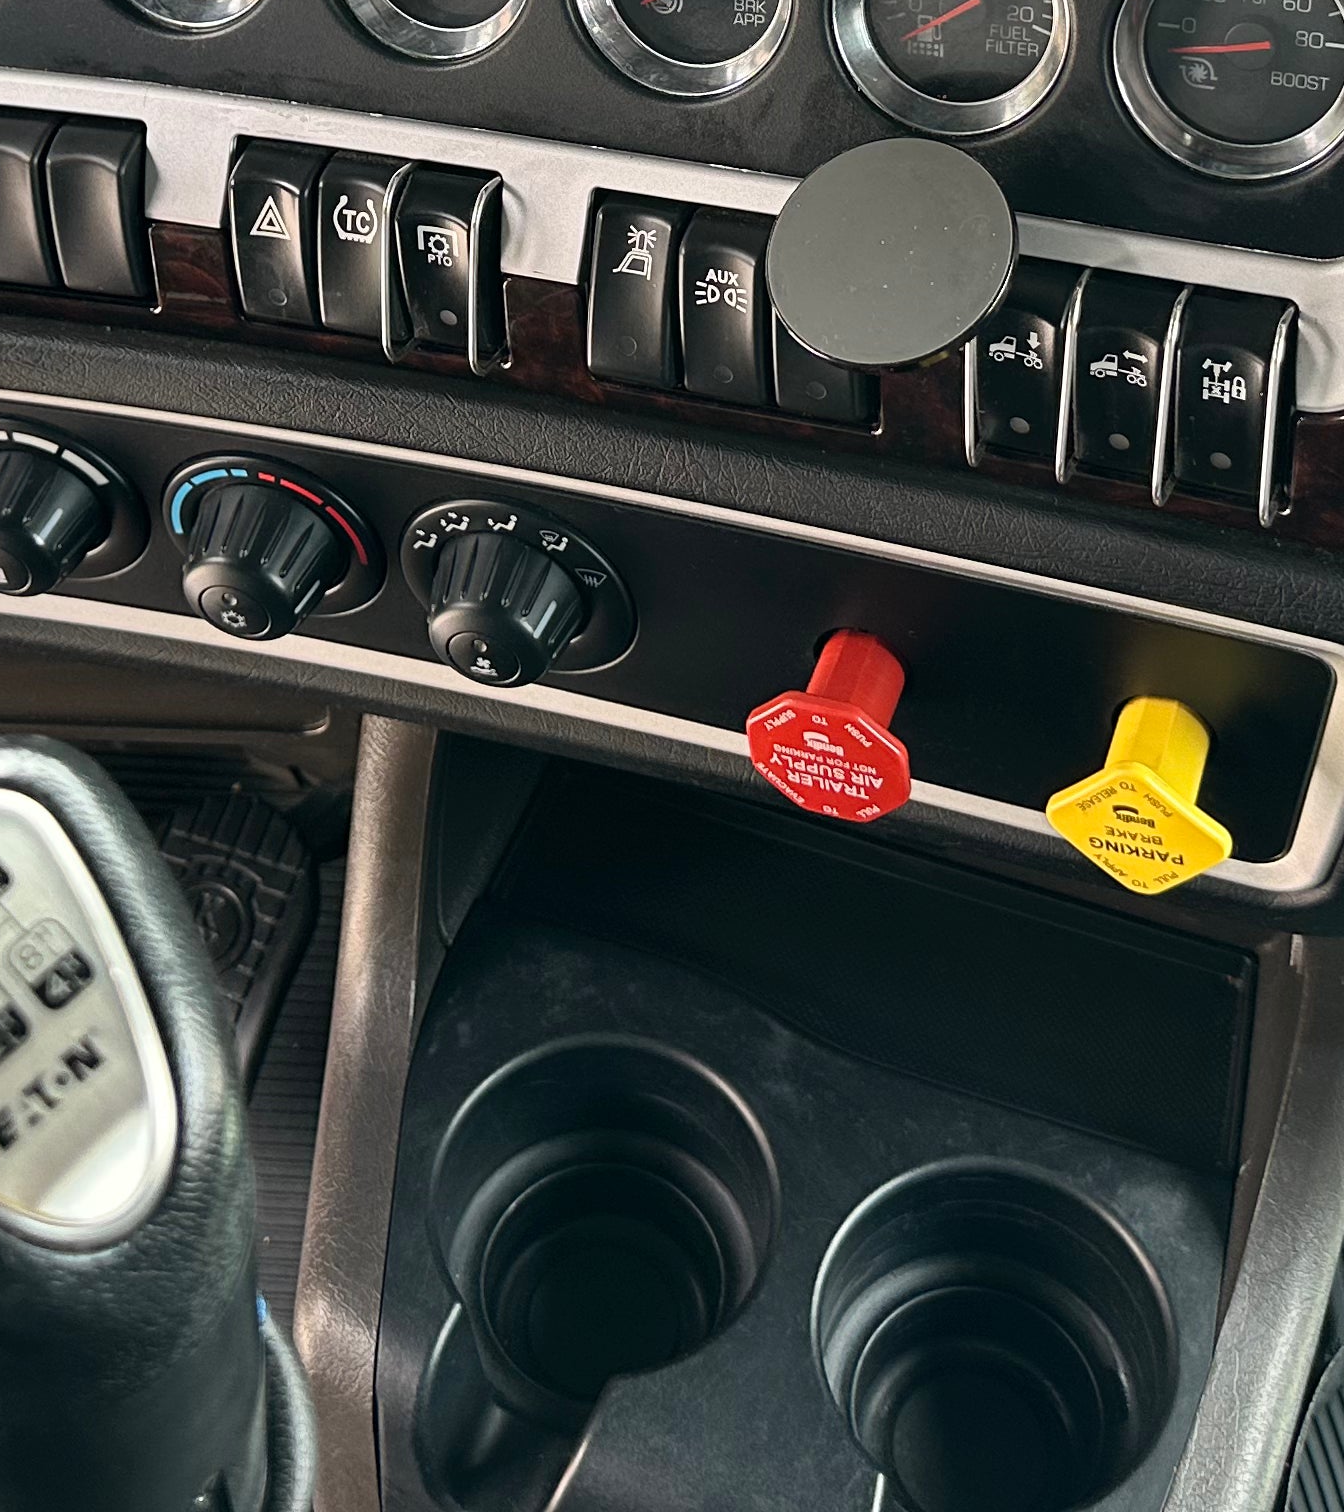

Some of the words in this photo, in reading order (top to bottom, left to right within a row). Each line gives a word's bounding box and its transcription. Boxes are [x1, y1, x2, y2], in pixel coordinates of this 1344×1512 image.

[732, 13, 766, 27] APP
[1007, 5, 1034, 23] 20
[989, 24, 1031, 42] FUEL
[1181, 17, 1196, 33] 0
[985, 39, 1039, 57] FILTER
[1295, 31, 1324, 49] 80
[1270, 71, 1331, 91] BOOST
[342, 209, 371, 234] TC
[428, 253, 454, 268] PTO
[706, 268, 739, 287] AUX
[762, 709, 798, 732] SUPPLY
[811, 714, 829, 727] TO
[843, 723, 873, 748] PUSH
[773, 743, 824, 764] PARKING
[806, 739, 845, 757] Bendix
[769, 752, 846, 781] SUPPLY
[825, 756, 847, 768] FOR
[849, 760, 877, 774] NOT
[755, 761, 806, 805] EVACUATE
[786, 769, 870, 800] TRAILER
[851, 773, 884, 790] AIR
[1119, 780, 1137, 793] TO
[1075, 785, 1118, 812] RELEASE
[1143, 793, 1173, 818] PUSH
[822, 804, 840, 817] TO
[855, 803, 881, 819] PULL
[1115, 812, 1156, 829] Bendix
[1104, 825, 1164, 846] BRAKE
[1088, 836, 1185, 866] PARKING
[1093, 853, 1128, 877] APPLY
[1131, 878, 1149, 889] TO
[1153, 871, 1179, 886] PULL
[17, 943, 45, 972] 8
